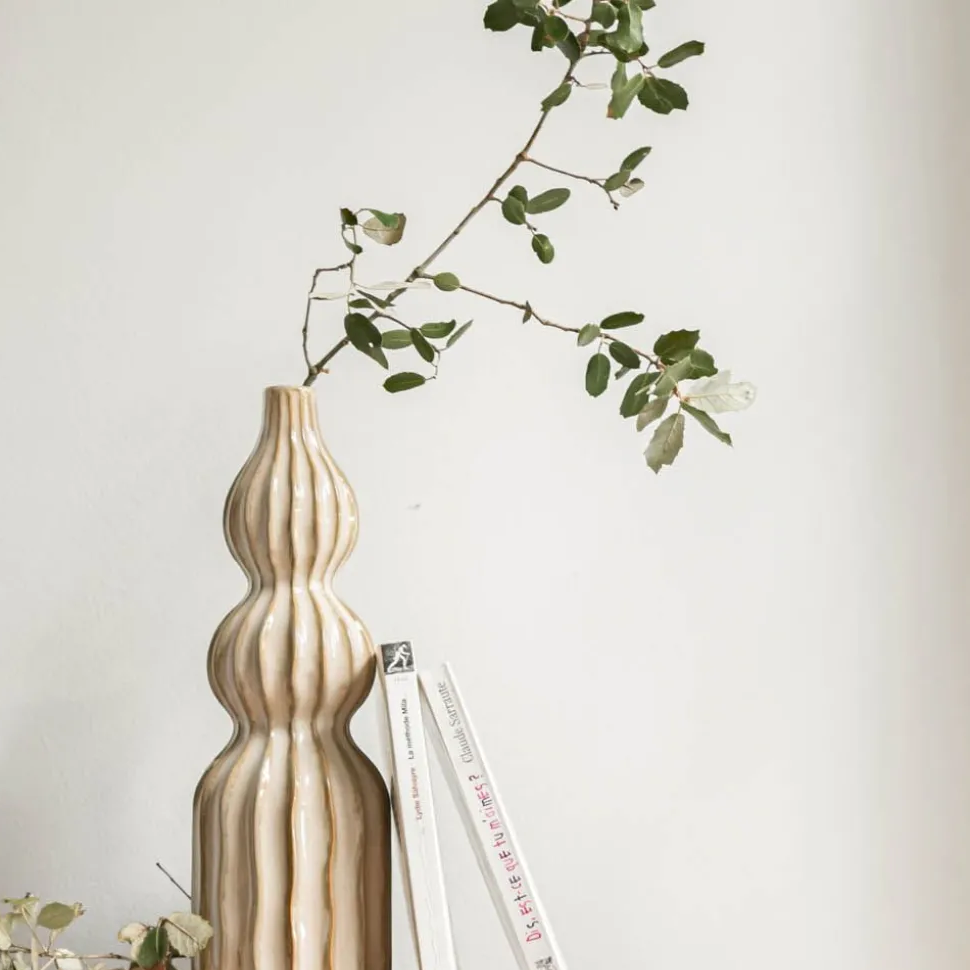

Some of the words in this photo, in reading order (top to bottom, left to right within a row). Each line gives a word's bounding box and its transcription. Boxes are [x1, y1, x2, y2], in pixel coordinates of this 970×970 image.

[437, 681, 461, 727] Sarraute
[453, 728, 474, 763] Claude
[493, 832, 506, 848] tu
